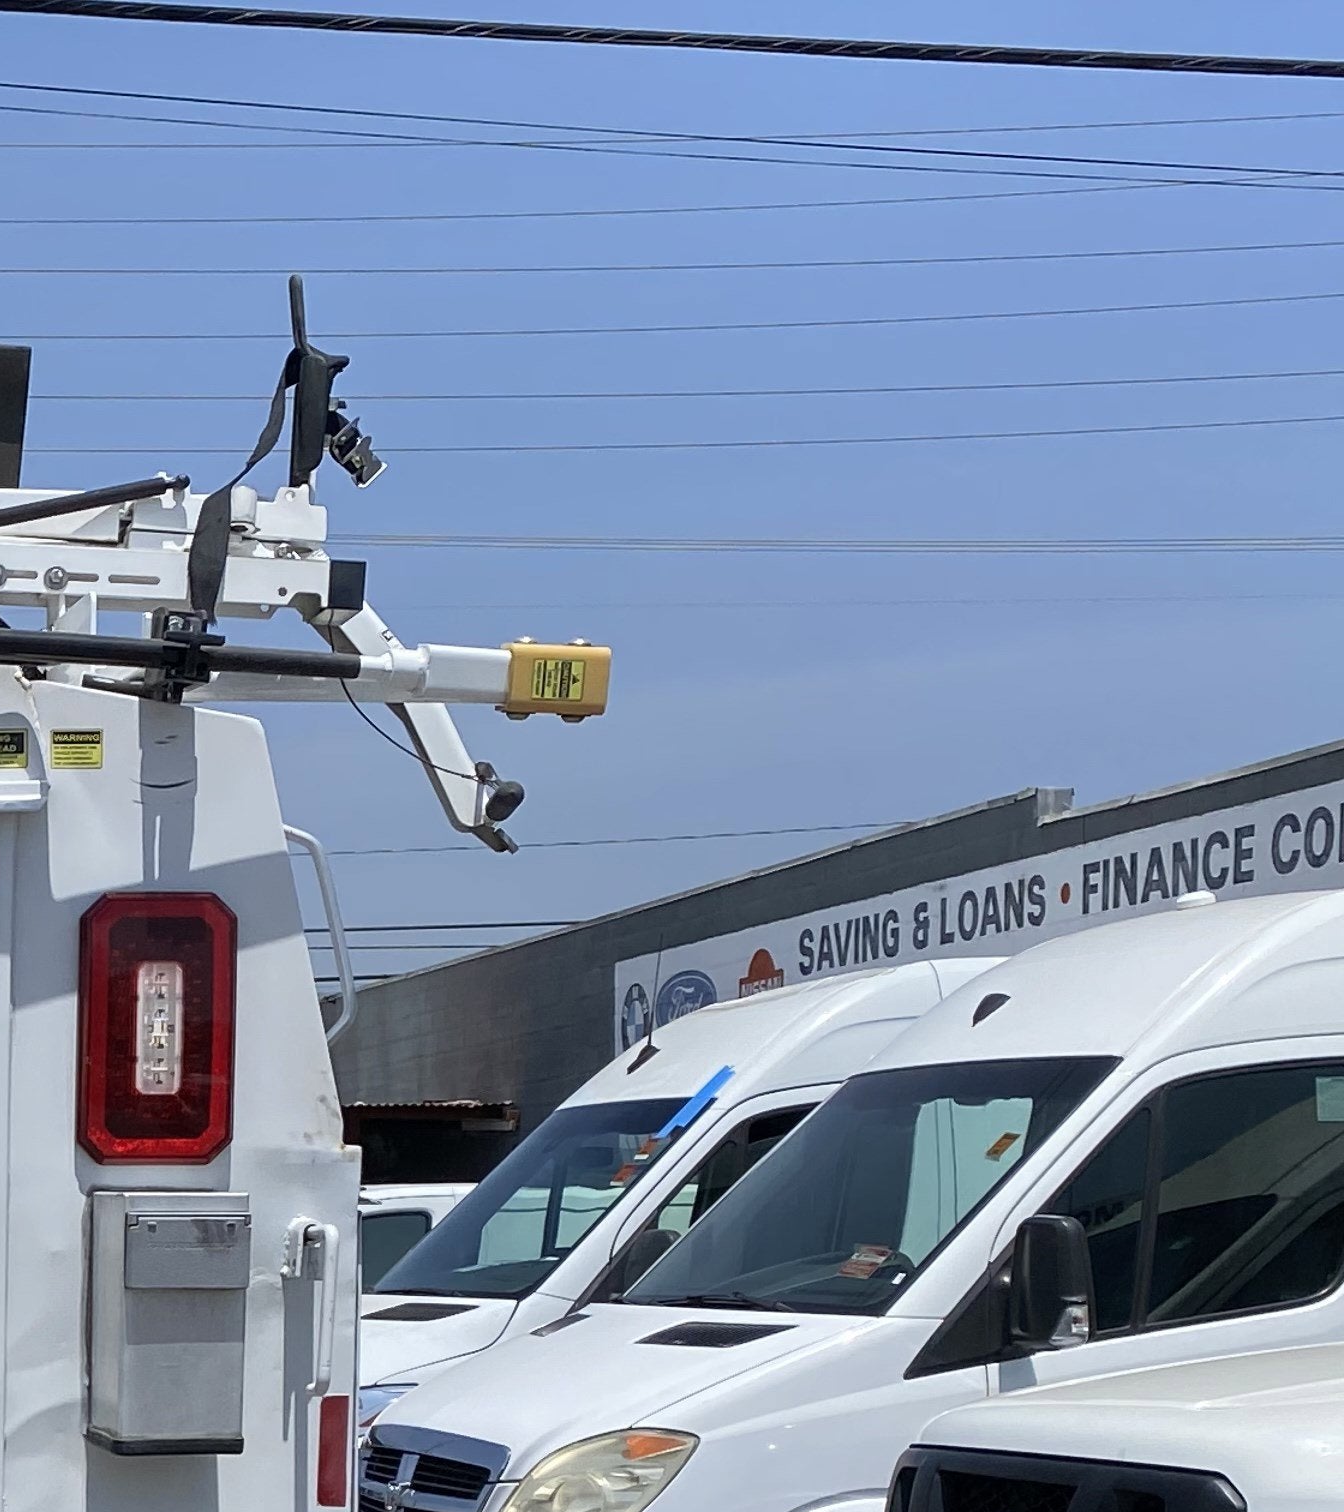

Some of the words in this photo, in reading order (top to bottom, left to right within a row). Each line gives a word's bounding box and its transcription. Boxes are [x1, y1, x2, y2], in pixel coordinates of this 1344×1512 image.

[53, 733, 100, 742] WARNING
[798, 909, 900, 977] SAVING
[912, 901, 929, 950] &
[939, 874, 1047, 945] LOANS
[1082, 823, 1256, 915] FINANCE
[1271, 803, 1344, 875] CO
